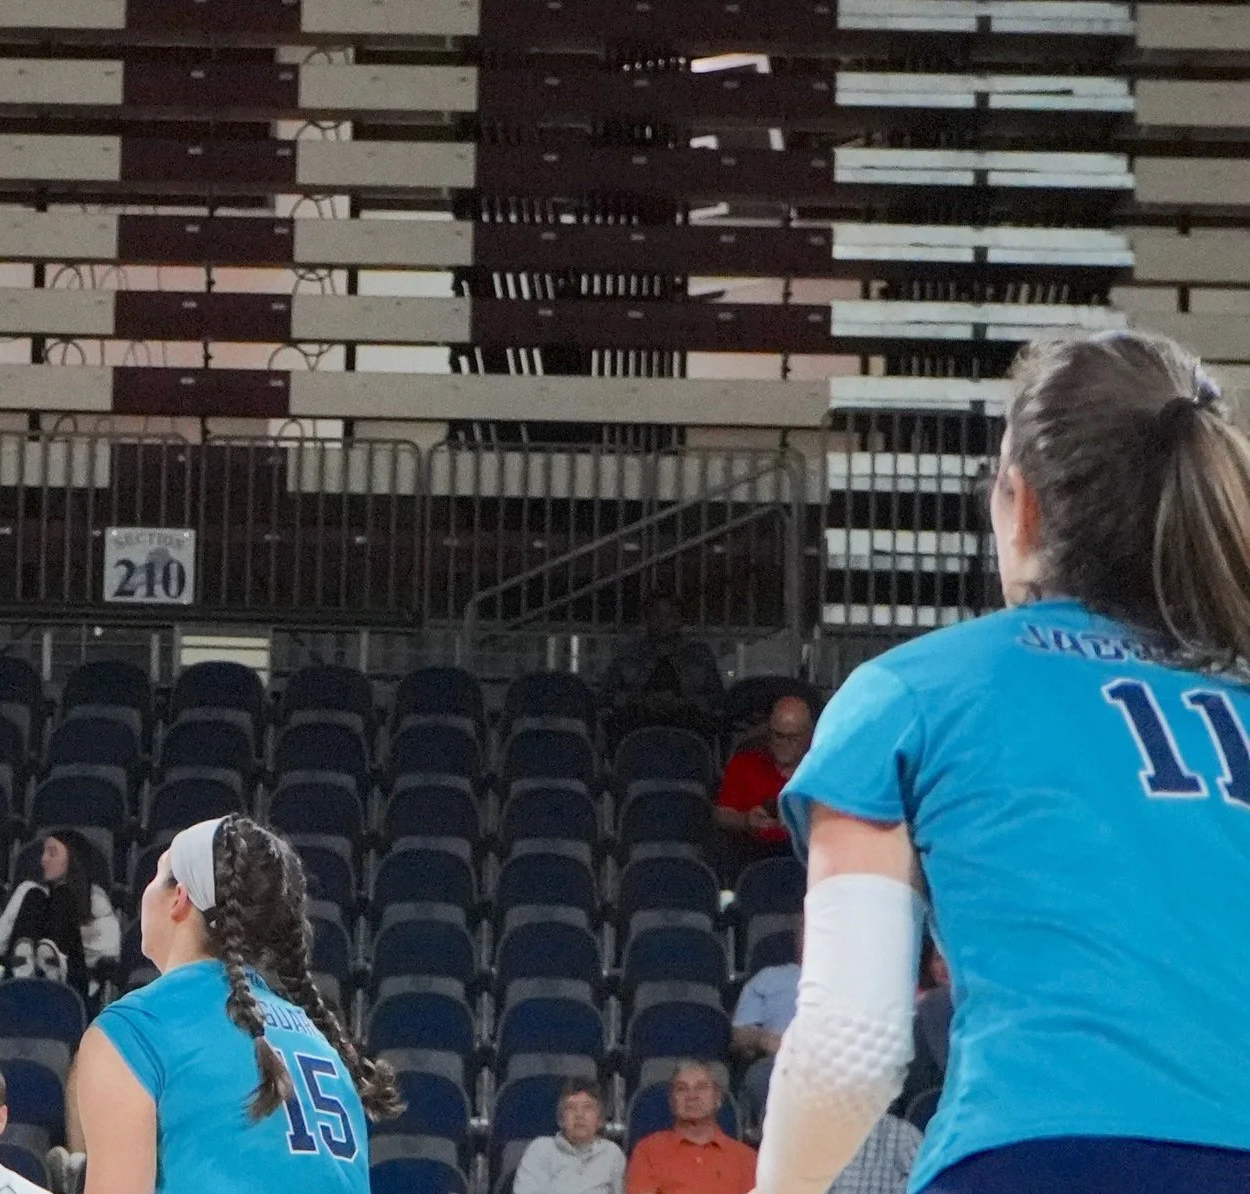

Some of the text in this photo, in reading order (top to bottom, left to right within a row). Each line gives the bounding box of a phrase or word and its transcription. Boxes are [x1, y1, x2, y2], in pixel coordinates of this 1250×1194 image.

[111, 557, 186, 599] 210
[1101, 677, 1250, 809] 11
[275, 1048, 359, 1163] 15
